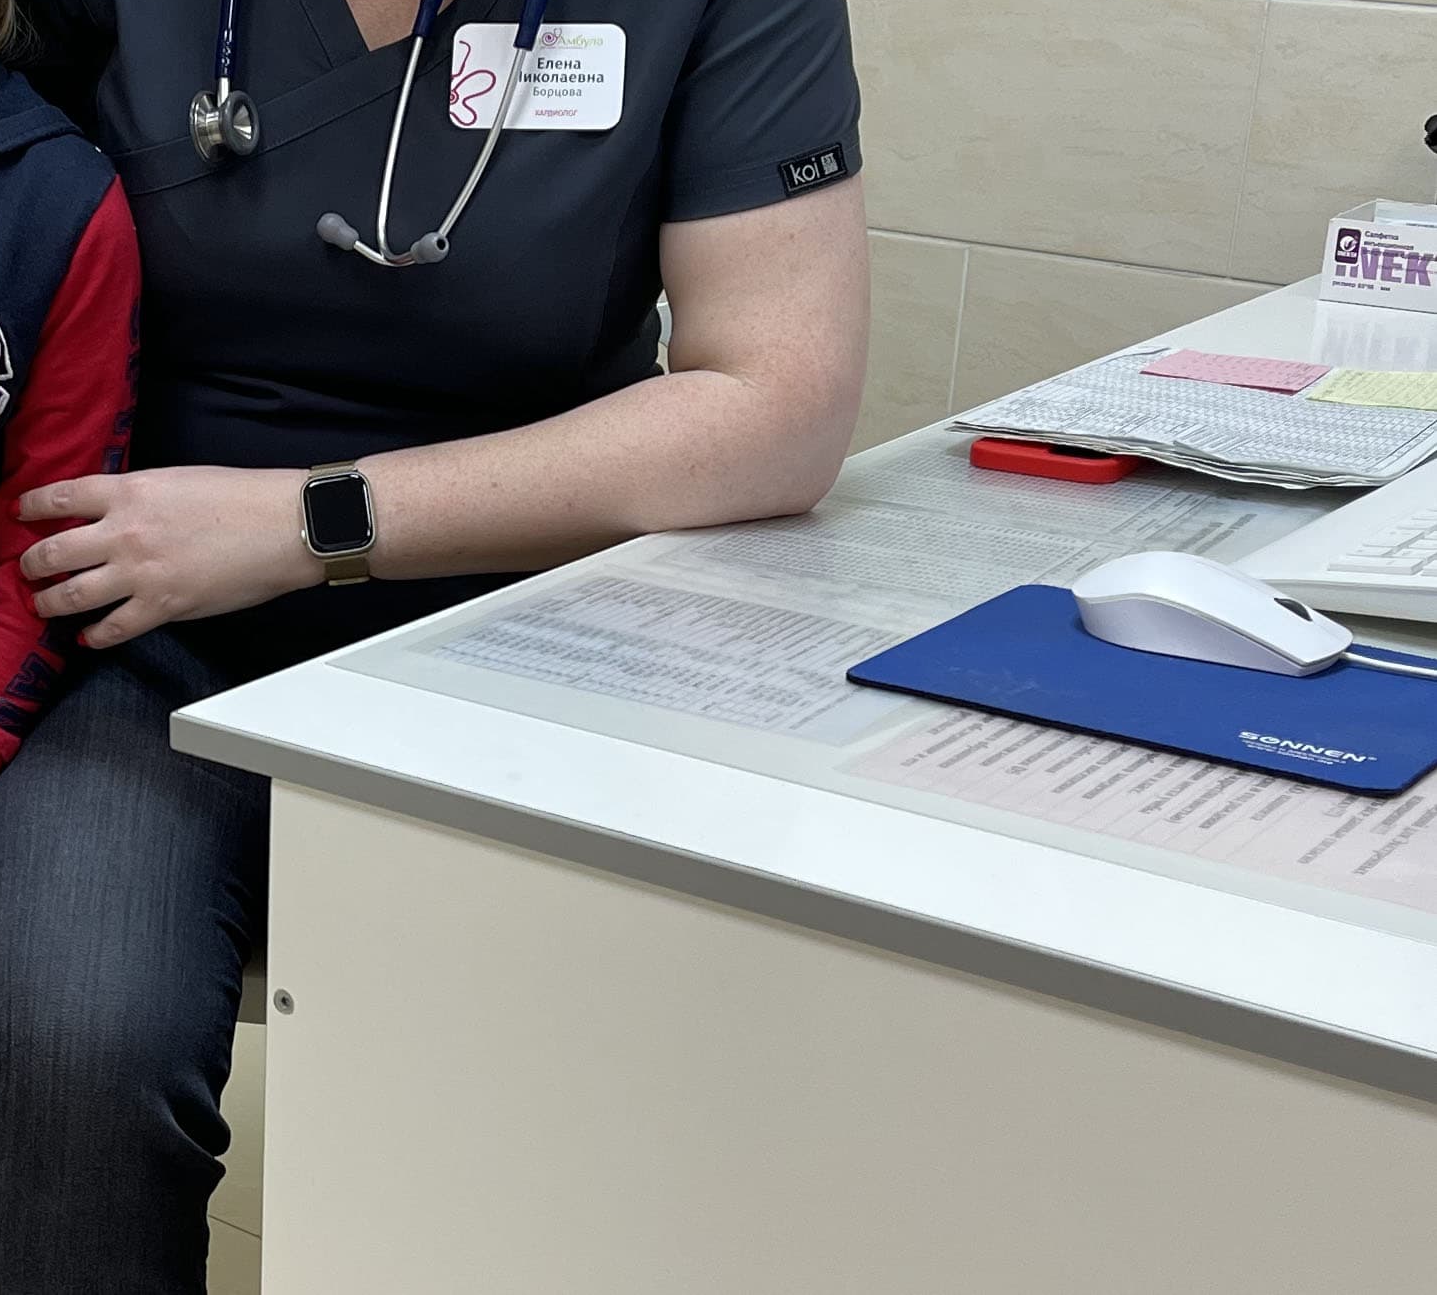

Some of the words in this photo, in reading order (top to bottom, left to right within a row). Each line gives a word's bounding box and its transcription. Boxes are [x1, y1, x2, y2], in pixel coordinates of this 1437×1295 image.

[537, 57, 582, 70] Елена
[533, 87, 583, 98] Борцова
[789, 157, 821, 186] koi
[1238, 731, 1367, 762] SONNEN
